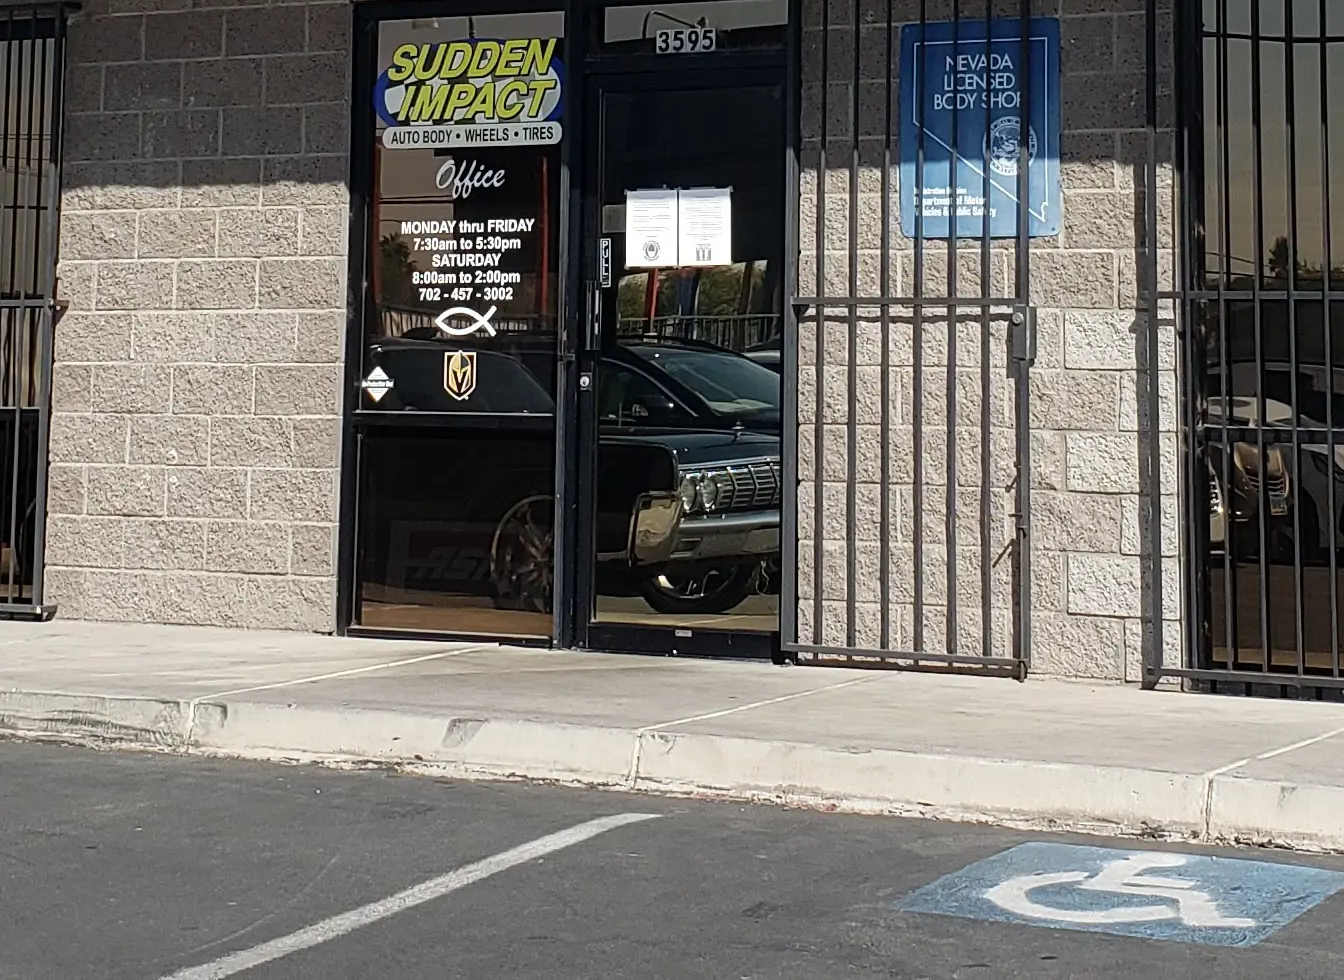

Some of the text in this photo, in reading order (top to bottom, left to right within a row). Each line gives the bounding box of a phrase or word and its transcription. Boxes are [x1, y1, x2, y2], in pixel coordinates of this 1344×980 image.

[658, 29, 714, 53] 3595
[387, 37, 558, 82] SUDDEN
[945, 53, 1014, 72] NEVADA
[943, 72, 1016, 91] LICENSED
[396, 79, 557, 122] IMPACT
[933, 92, 978, 111] BODY
[391, 125, 554, 145] AUTO BODY WHEELS TIRES
[435, 159, 506, 199] Office
[400, 218, 535, 235] MONDAY thru FRIDAY
[413, 236, 522, 252] 7:30am to 5:30pm
[431, 253, 502, 268] SATURDAY
[412, 270, 521, 286] 8:00am to 2:00pm
[418, 288, 441, 301] 702
[451, 287, 473, 301] 457
[484, 287, 513, 301] 3002
